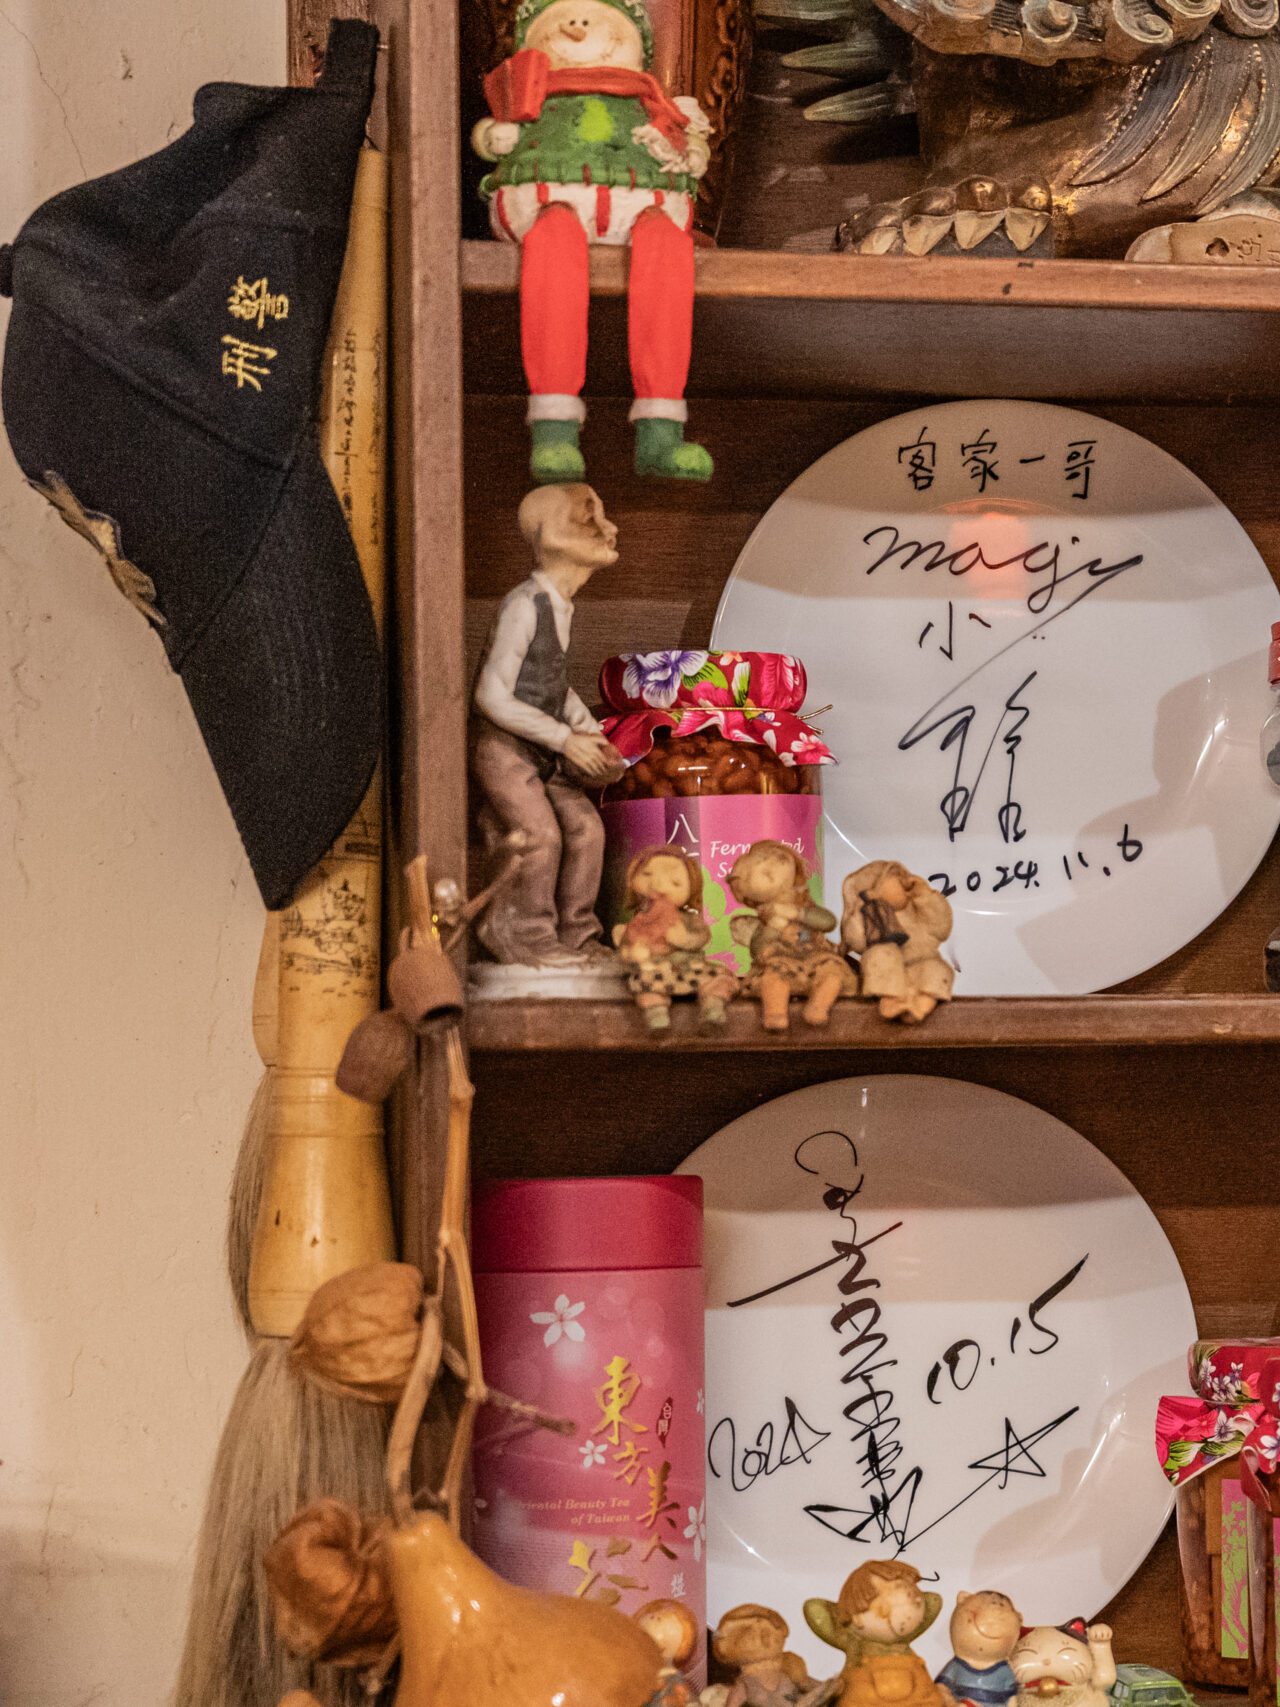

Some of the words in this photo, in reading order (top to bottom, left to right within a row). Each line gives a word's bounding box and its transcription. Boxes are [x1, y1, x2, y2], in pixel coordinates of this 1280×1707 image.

[898, 427, 1098, 499] 客家一哥
[609, 1497, 631, 1507] Tea
[586, 1513, 631, 1524] Taiwan
